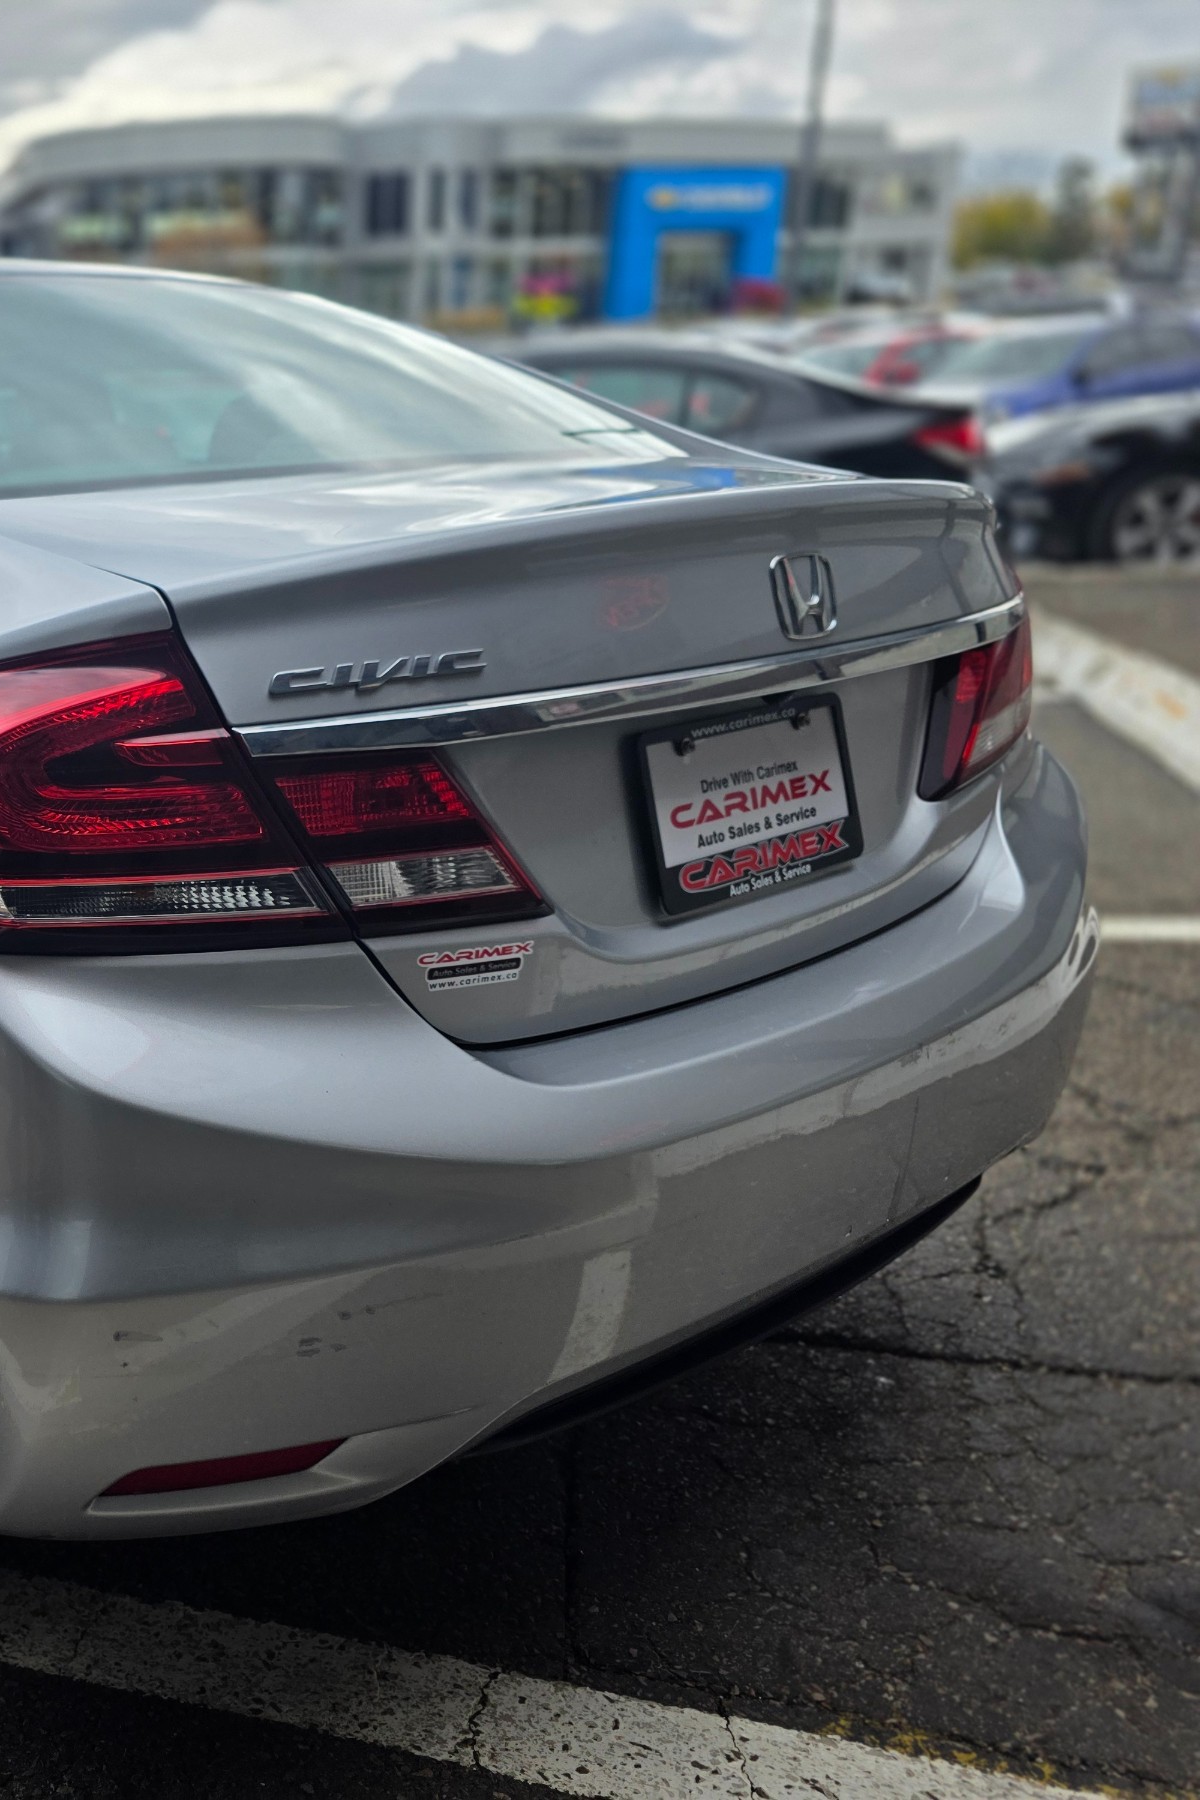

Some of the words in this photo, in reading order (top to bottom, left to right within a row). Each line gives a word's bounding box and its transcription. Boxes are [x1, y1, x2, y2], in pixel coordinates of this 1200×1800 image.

[269, 648, 488, 695] CIVIC
[691, 707, 796, 738] www.carimex.ca
[700, 778, 729, 793] Drive
[730, 769, 755, 787] With
[756, 760, 798, 780] Carimex
[670, 769, 832, 829] CARIMEX
[697, 831, 725, 848] Auto
[728, 822, 761, 840] Sales
[764, 817, 773, 829] &
[776, 806, 817, 827] Service
[680, 822, 847, 891] CARIMEX
[730, 878, 750, 897] Auto
[750, 873, 774, 891] Sales
[782, 862, 812, 880] Service
[418, 943, 532, 965] CARIMEX
[433, 969, 453, 977] Auto
[455, 965, 478, 975] Sales
[488, 960, 517, 970] Service
[429, 972, 517, 989] www.carimex.ca
